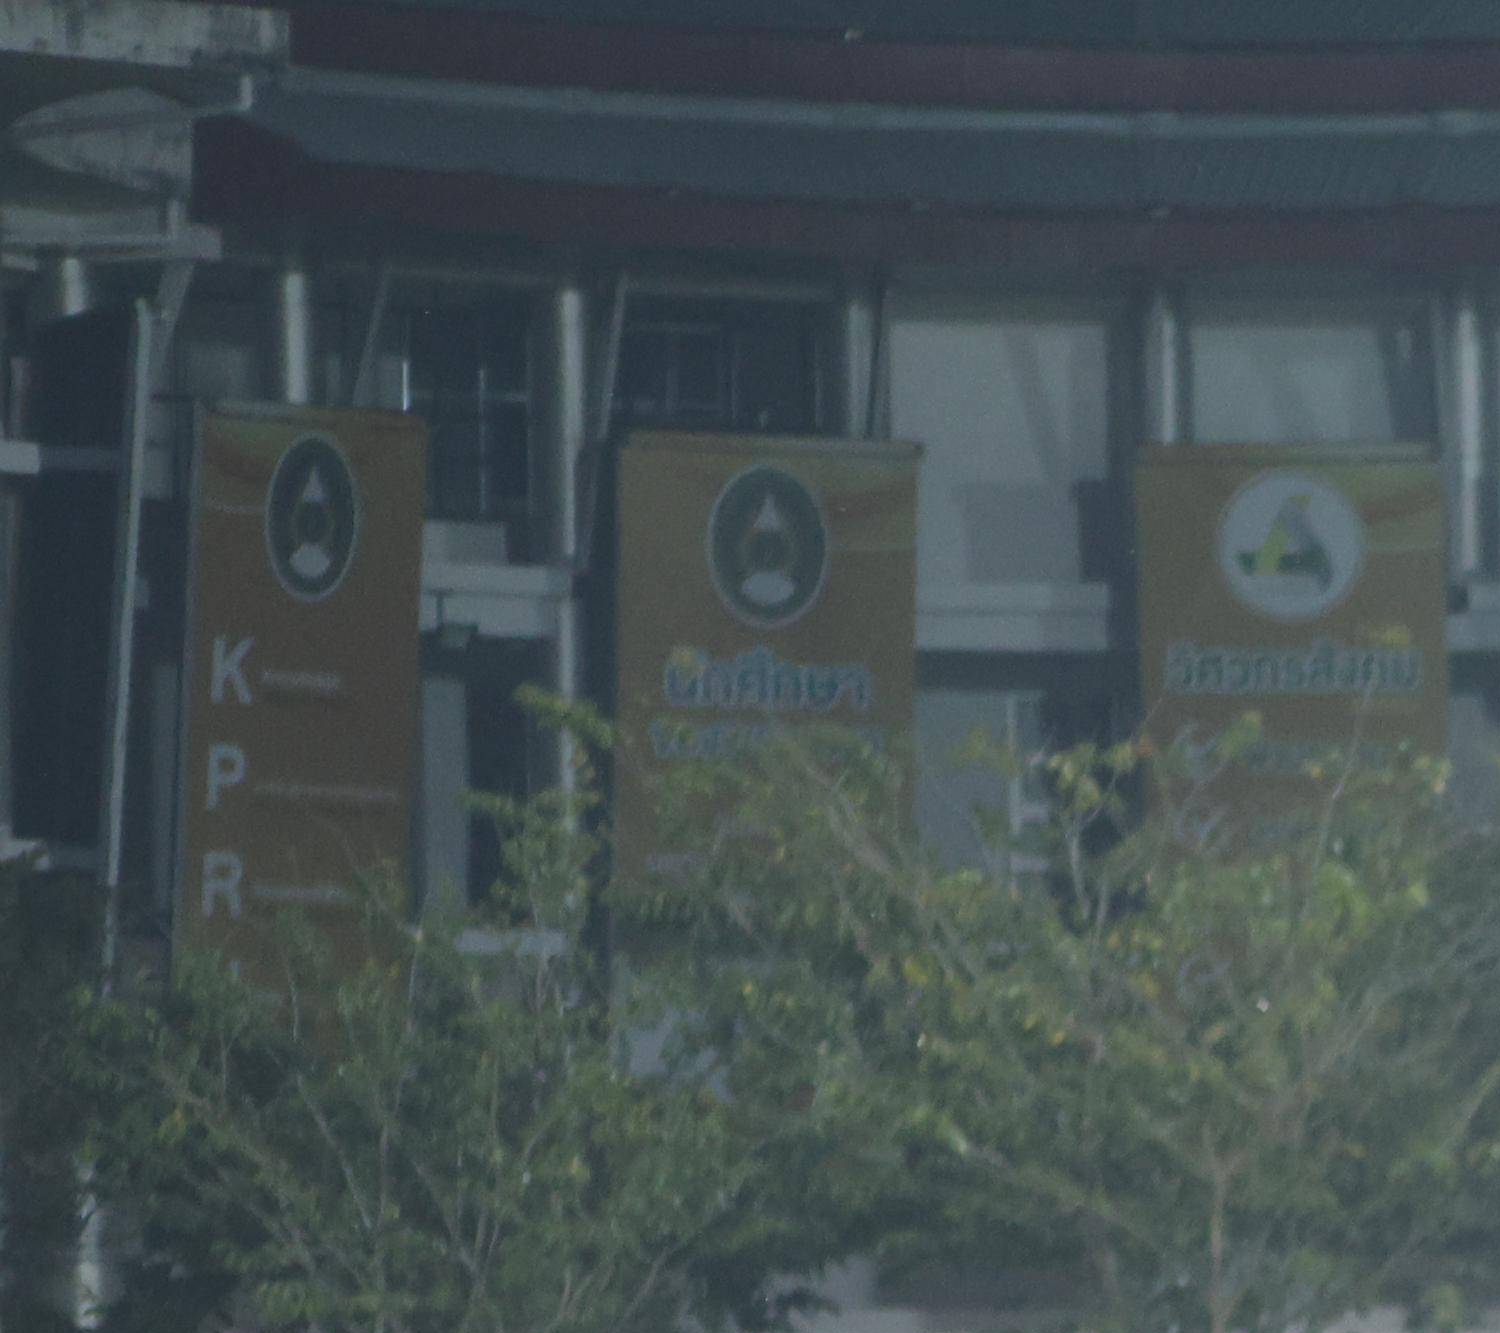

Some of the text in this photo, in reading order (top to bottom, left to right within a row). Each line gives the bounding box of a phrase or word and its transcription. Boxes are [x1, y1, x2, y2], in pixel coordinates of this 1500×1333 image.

[210, 633, 256, 706] K
[206, 742, 246, 812] P
[200, 850, 244, 920] R
